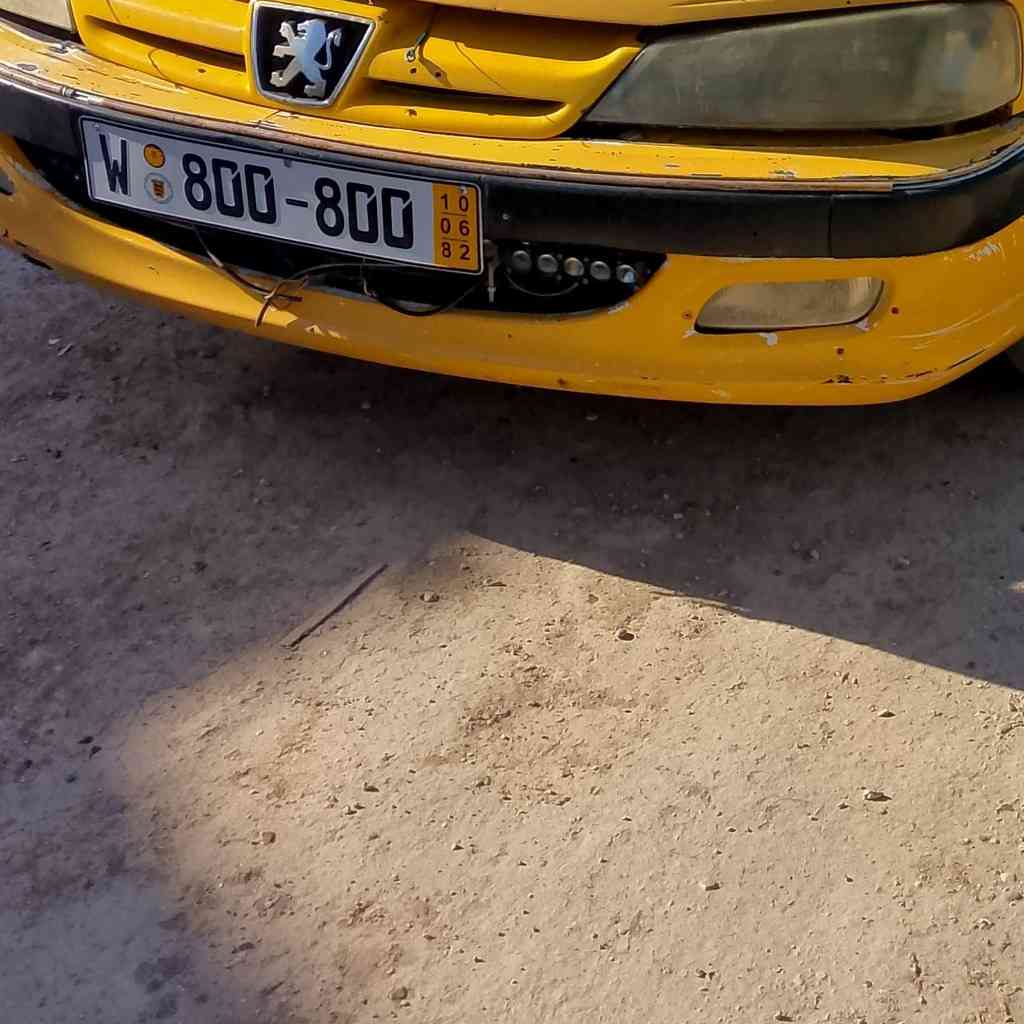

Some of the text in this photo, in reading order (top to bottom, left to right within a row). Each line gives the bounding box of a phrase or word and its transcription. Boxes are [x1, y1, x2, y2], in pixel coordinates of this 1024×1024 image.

[98, 133, 129, 196] W
[440, 193, 469, 213] 10
[440, 217, 470, 236] 06
[441, 241, 471, 261] 82
